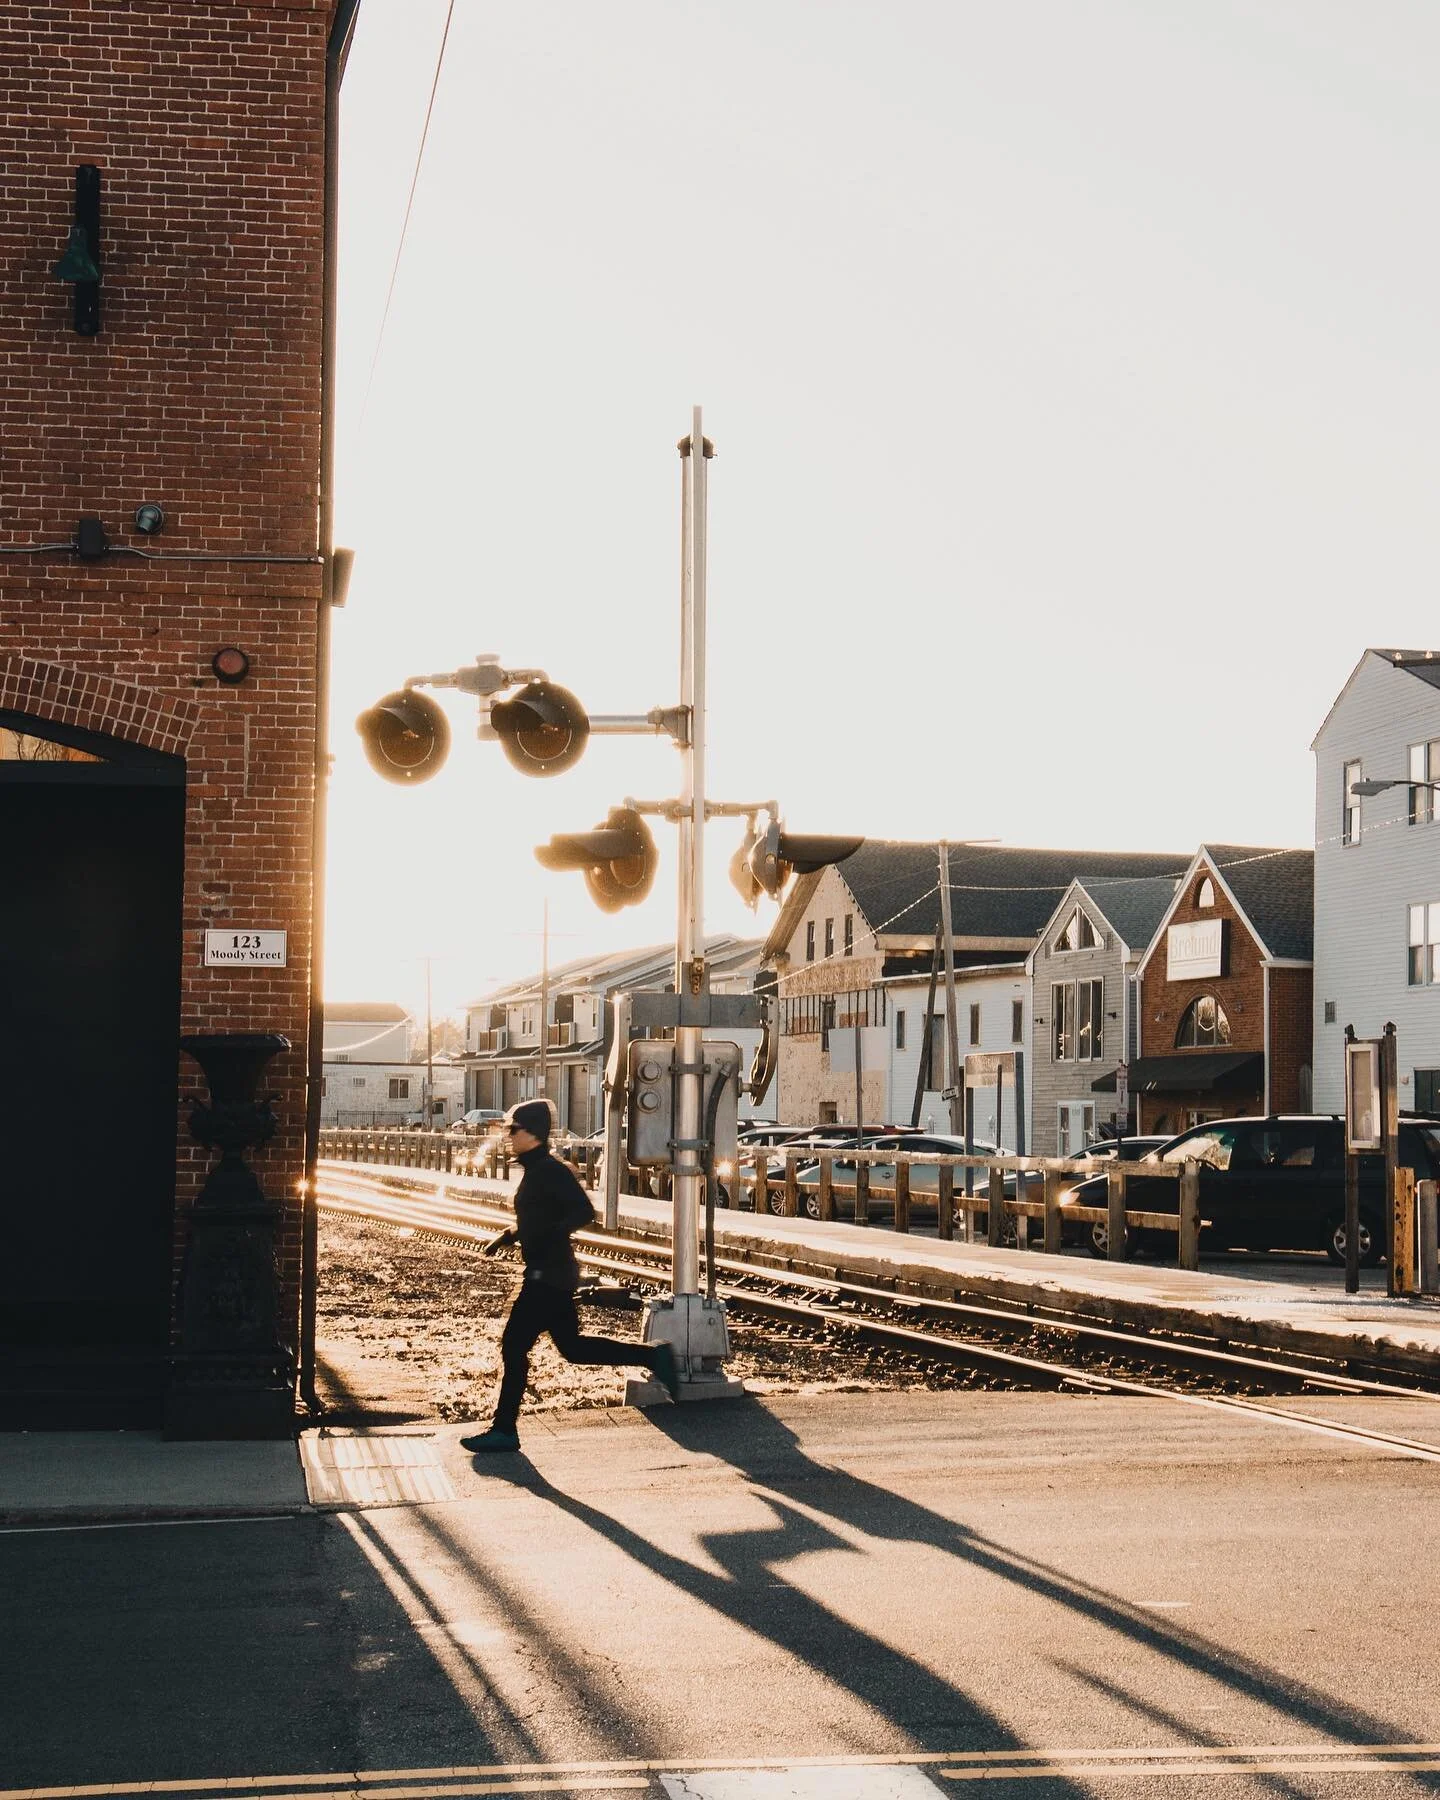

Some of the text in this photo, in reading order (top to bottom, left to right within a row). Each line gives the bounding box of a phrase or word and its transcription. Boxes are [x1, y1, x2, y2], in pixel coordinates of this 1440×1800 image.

[232, 935, 261, 949] 123
[210, 950, 281, 961] Moody Street
